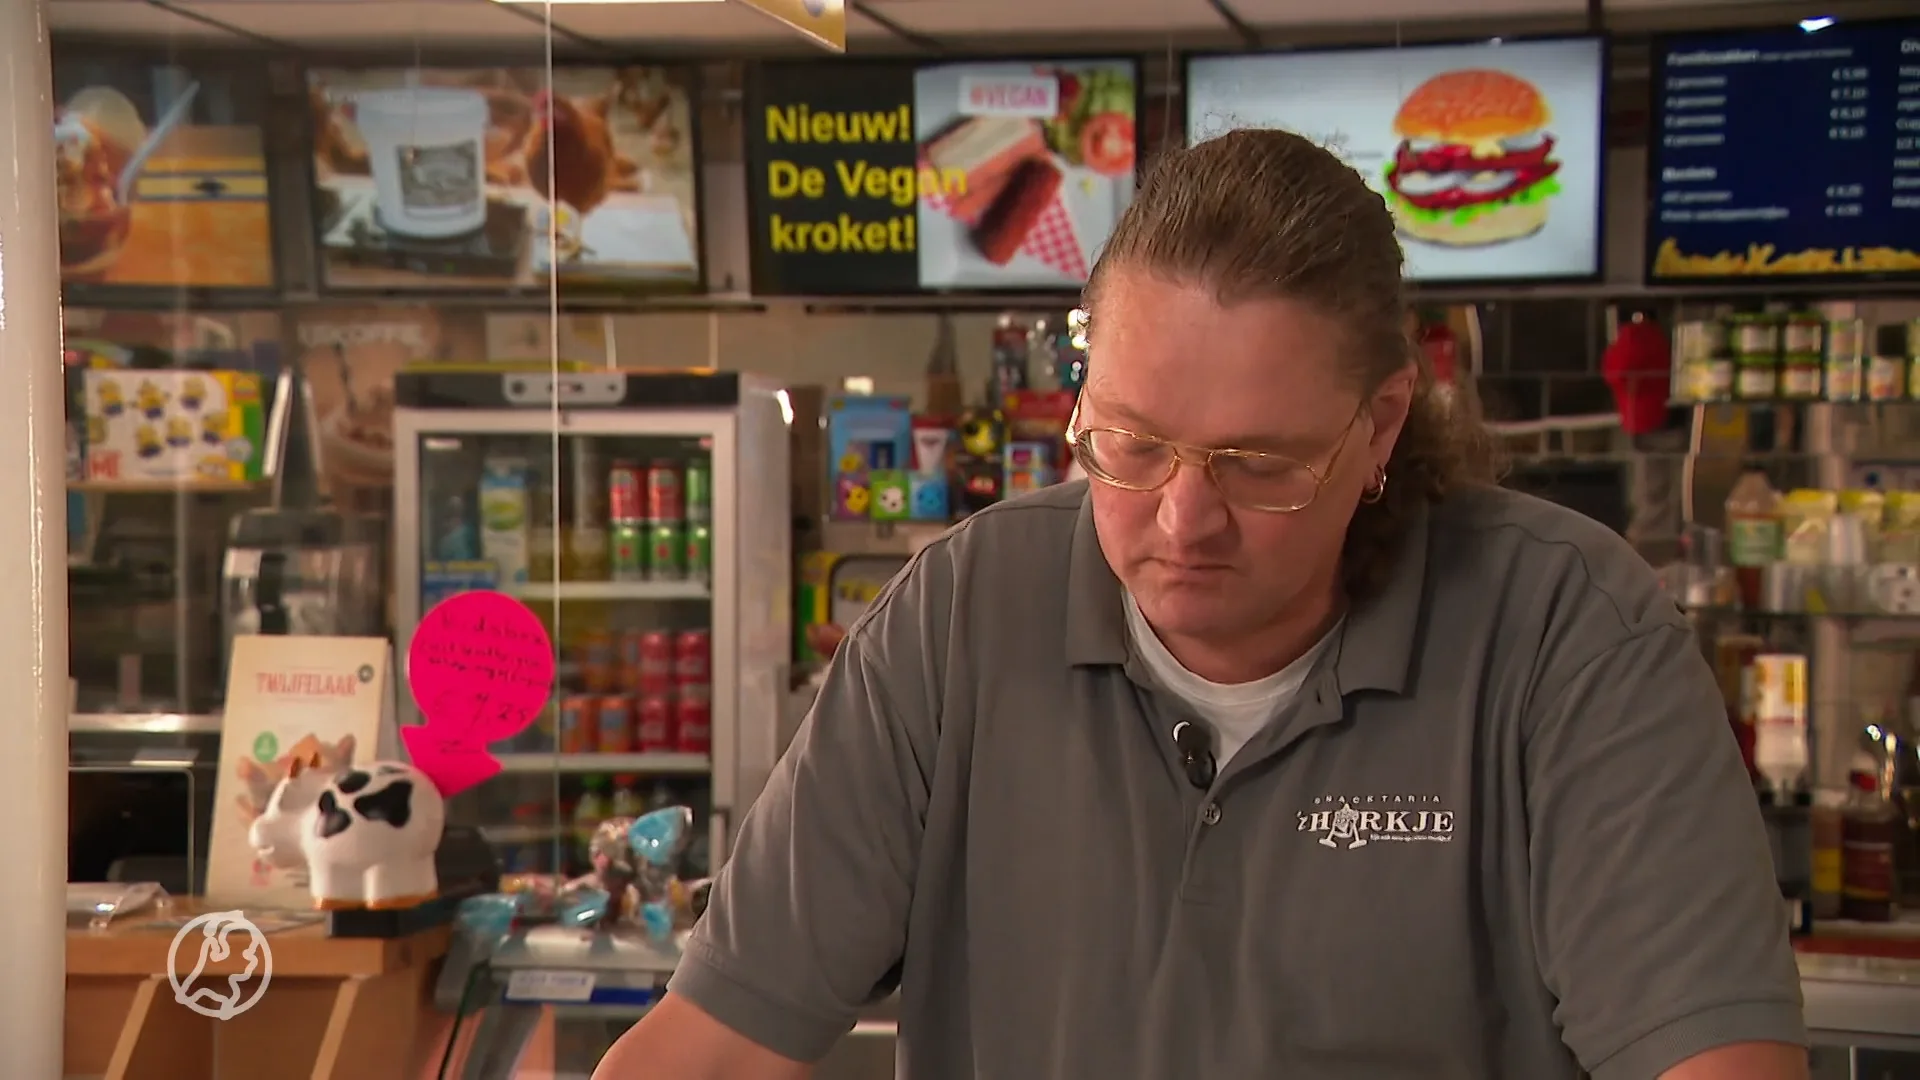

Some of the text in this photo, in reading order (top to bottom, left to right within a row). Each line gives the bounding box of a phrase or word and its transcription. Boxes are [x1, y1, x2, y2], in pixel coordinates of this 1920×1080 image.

[765, 104, 910, 143] Nieuw!
[768, 159, 967, 206] De Vegan
[769, 214, 915, 253] kroket!
